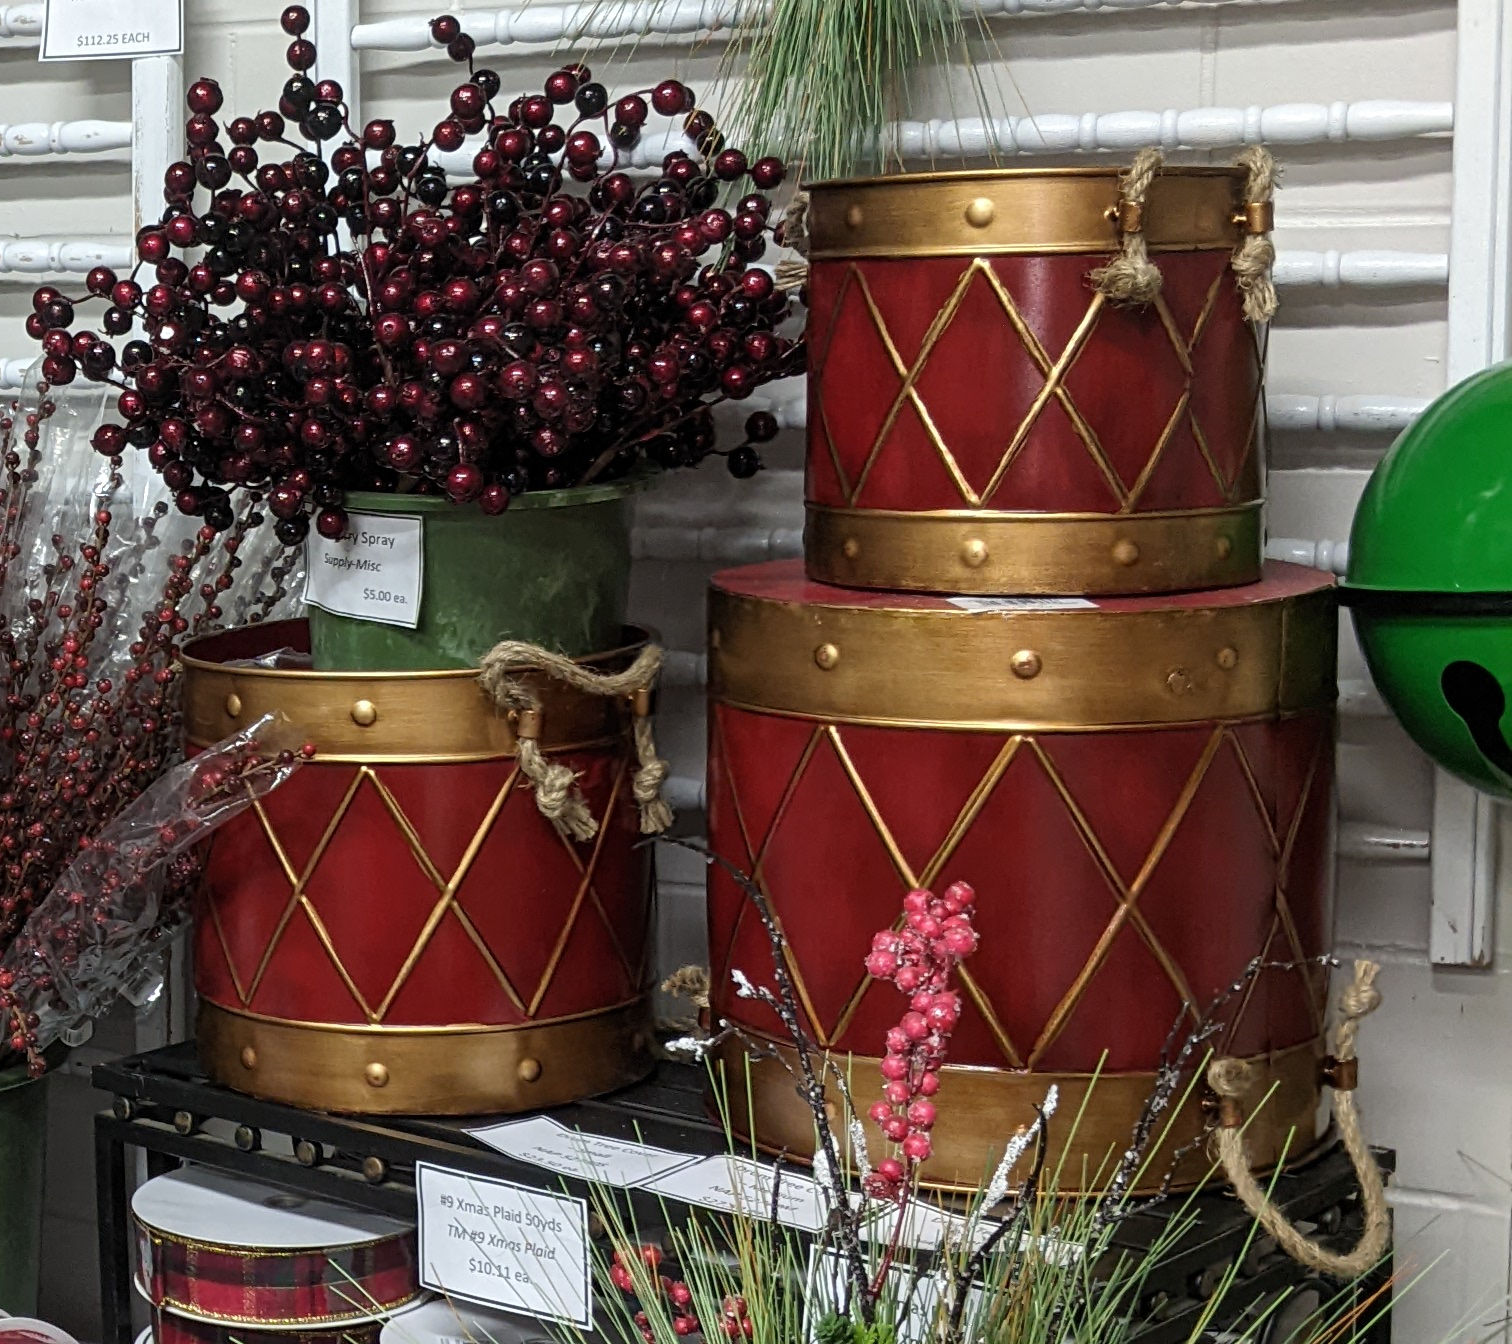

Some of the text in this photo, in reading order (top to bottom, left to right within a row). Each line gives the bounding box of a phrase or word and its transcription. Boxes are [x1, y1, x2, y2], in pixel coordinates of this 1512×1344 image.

[77, 32, 150, 47] $112.25 EACH
[361, 532, 395, 548] Spray
[324, 553, 382, 572] Supply-Misc
[363, 588, 408, 604] $5.00 ea.
[440, 1194, 562, 1233] #9 Xmas Plaid 50yds
[447, 1224, 556, 1261] TM #9 Xmas Plaid
[468, 1258, 511, 1280] $10.11
